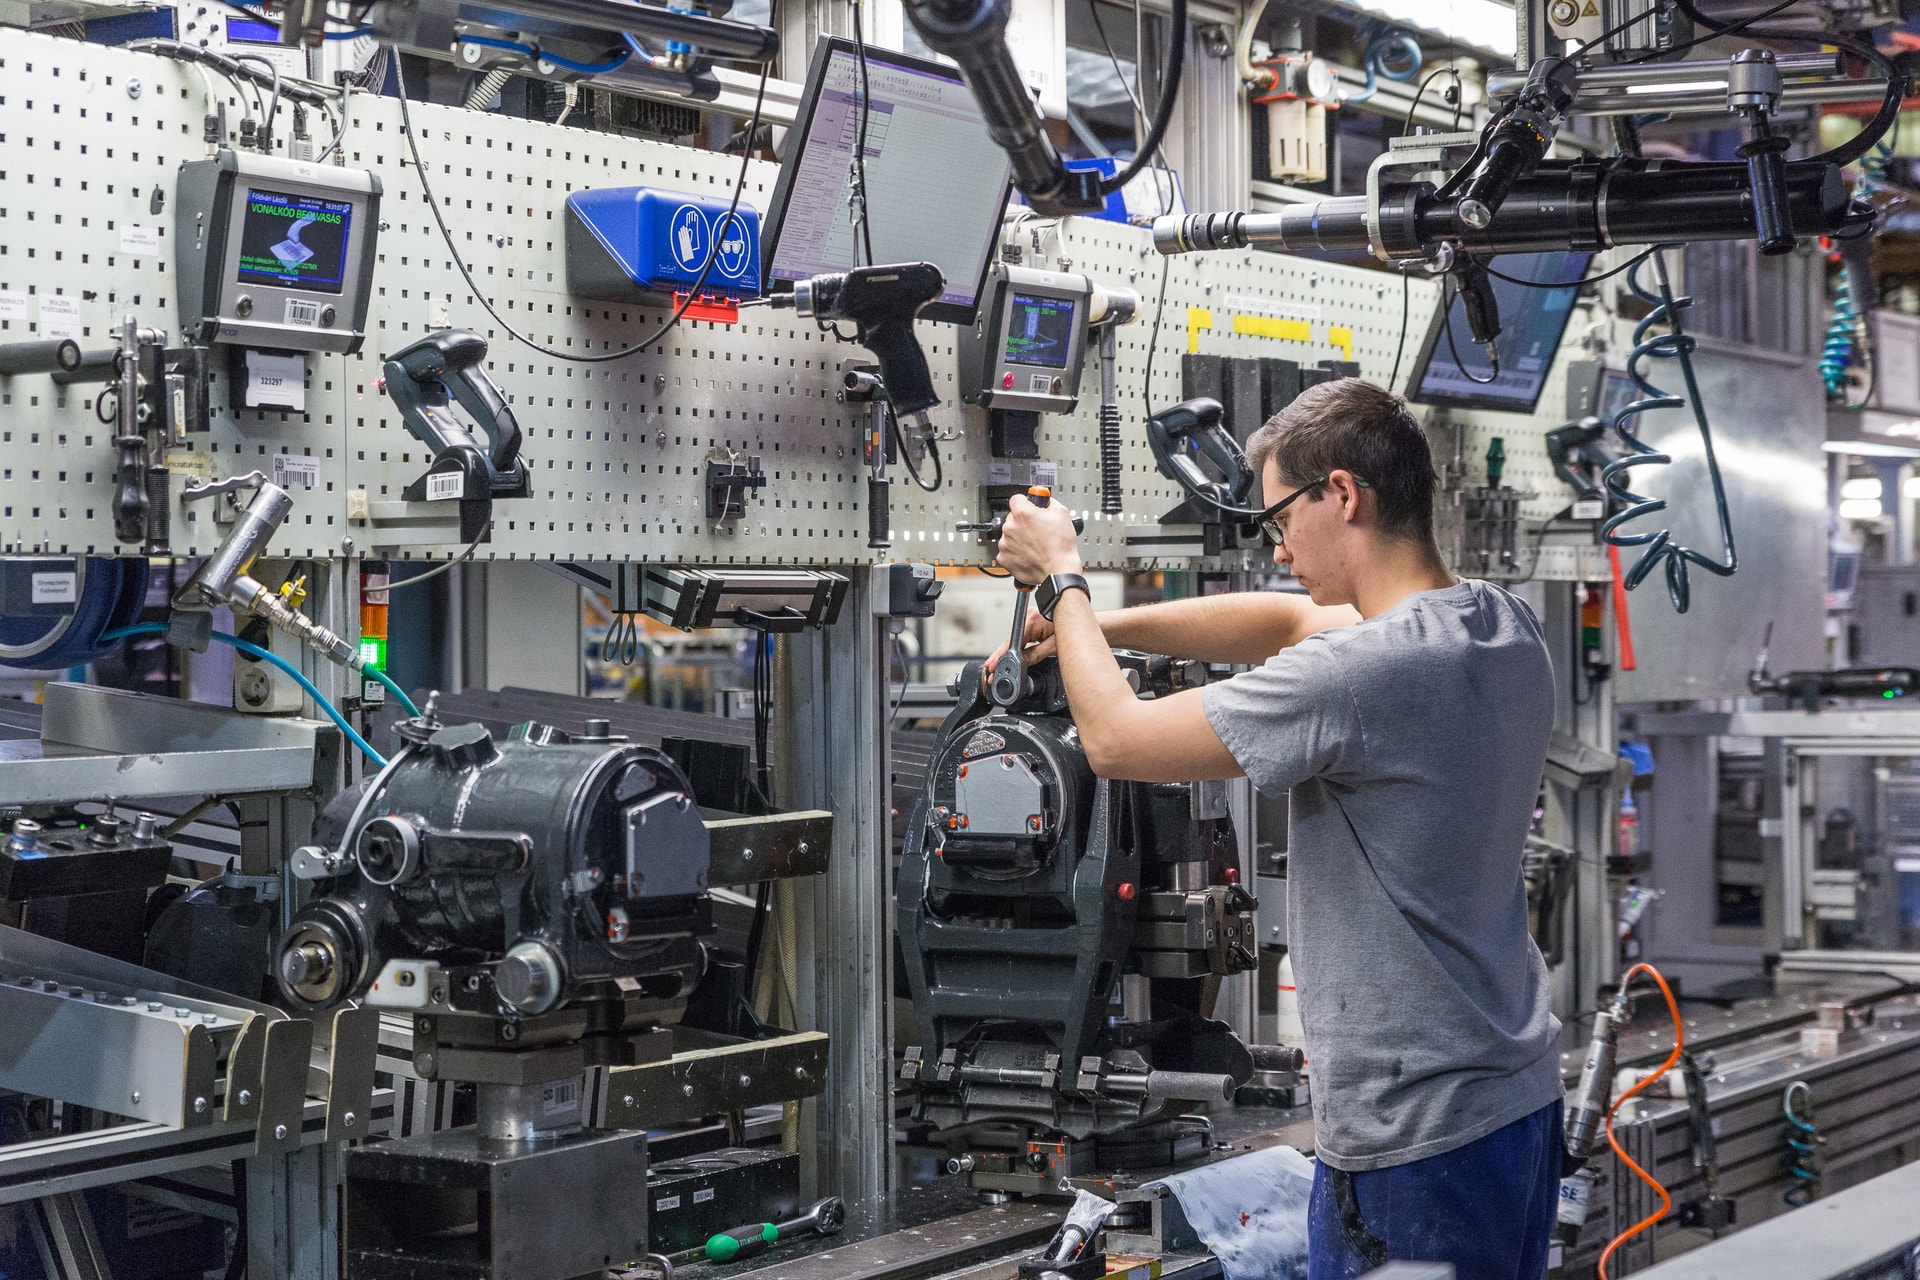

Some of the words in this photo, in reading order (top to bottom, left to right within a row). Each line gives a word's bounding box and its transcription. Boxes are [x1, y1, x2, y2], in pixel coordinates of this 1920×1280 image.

[251, 203, 296, 219] VONALKÓD
[296, 209, 343, 225] BEOLVASÁS
[260, 376, 283, 387] 323297
